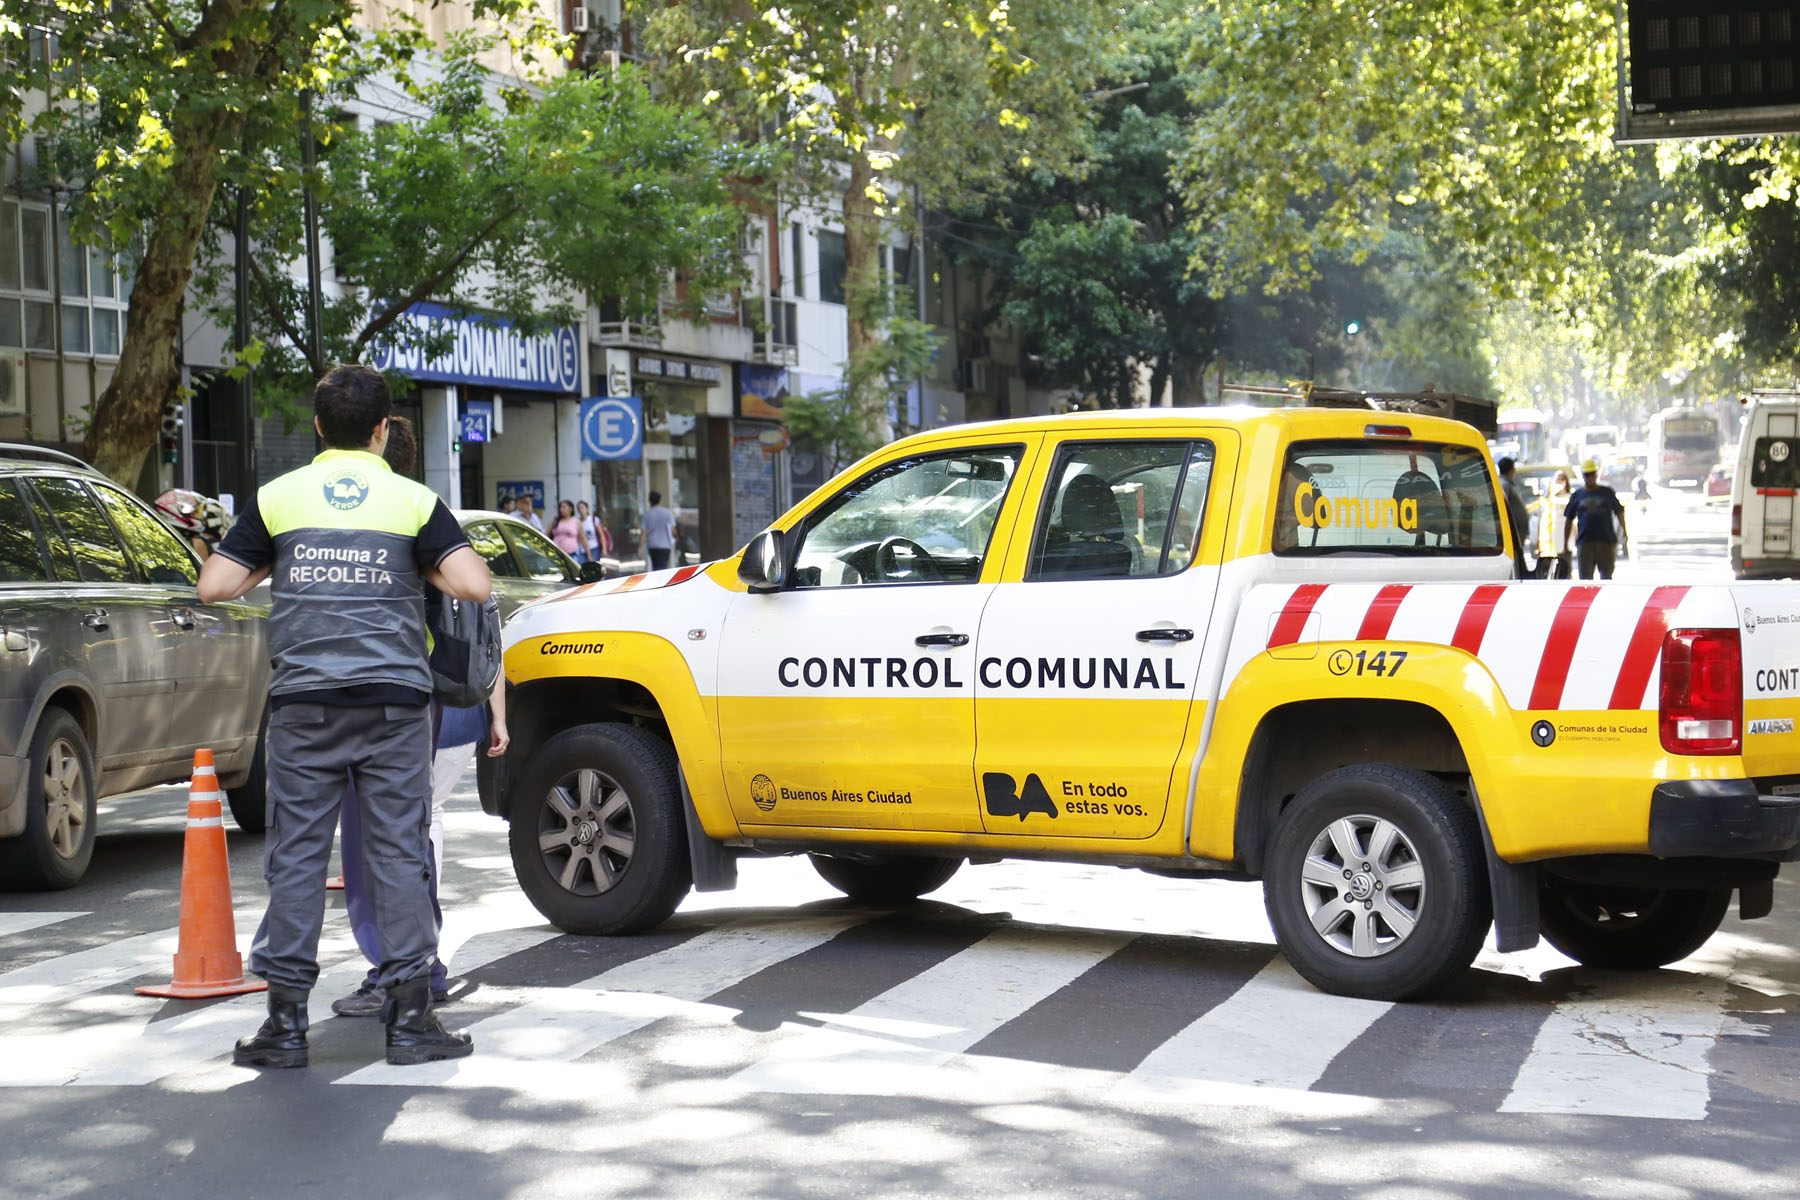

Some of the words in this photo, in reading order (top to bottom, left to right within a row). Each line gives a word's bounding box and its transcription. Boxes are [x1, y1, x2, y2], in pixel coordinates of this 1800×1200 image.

[562, 338, 573, 376] E
[465, 416, 484, 433] 24
[598, 411, 624, 446] E
[1772, 443, 1788, 458] 80
[333, 483, 361, 499] BA
[330, 497, 360, 510] VERDE
[1294, 481, 1418, 529] Comuna
[294, 544, 371, 563] Comuna
[375, 549, 388, 565] 2
[289, 566, 392, 585] RECOLETA
[1756, 615, 1776, 625] Buenos
[1777, 615, 1790, 624] Aires
[540, 641, 604, 655] Comuna
[1355, 650, 1408, 677] 147
[778, 657, 963, 688] CONTROL
[979, 657, 1186, 689] COMUNAL
[1756, 668, 1799, 692] CONT
[1558, 725, 1595, 733] Comunas
[1596, 725, 1607, 733] de
[1609, 725, 1617, 733] la
[1618, 725, 1648, 733] Ciudad
[781, 788, 828, 802] Buenos
[831, 789, 864, 803] Aires
[867, 790, 912, 804] Ciudad
[982, 772, 1058, 822] BA
[1062, 781, 1084, 796] En
[1089, 782, 1128, 798] todo
[1065, 800, 1109, 815] estas
[1113, 803, 1148, 816] vos.
